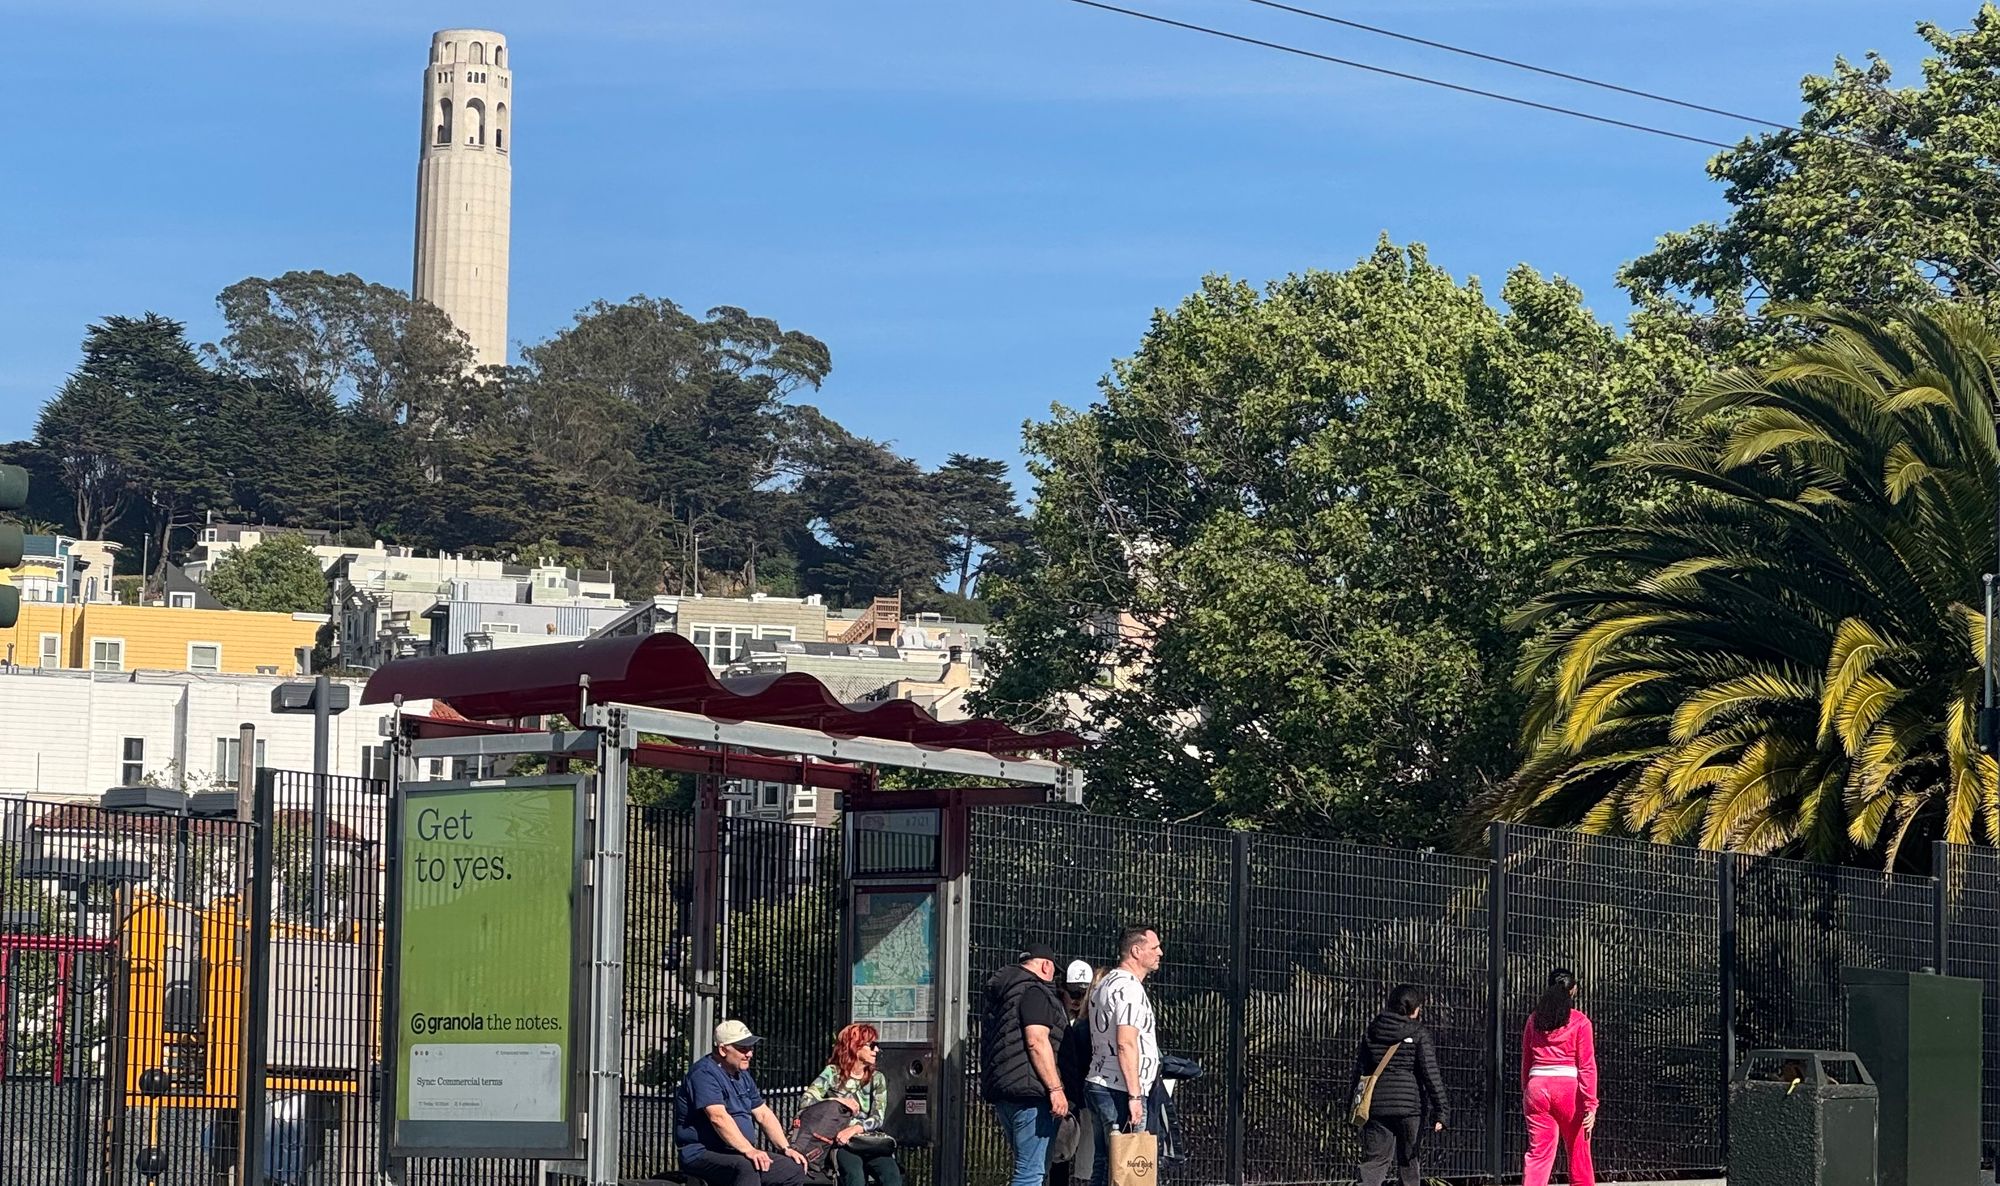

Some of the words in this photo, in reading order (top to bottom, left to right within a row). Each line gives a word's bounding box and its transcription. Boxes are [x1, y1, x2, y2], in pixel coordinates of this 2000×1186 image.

[418, 808, 473, 841] Get
[415, 852, 445, 882] to
[453, 856, 512, 889] yes.
[427, 1012, 484, 1035] granola
[487, 1013, 512, 1031] the
[515, 1014, 562, 1031] notes.
[437, 1077, 480, 1086] Commercial
[481, 1078, 503, 1086] terms
